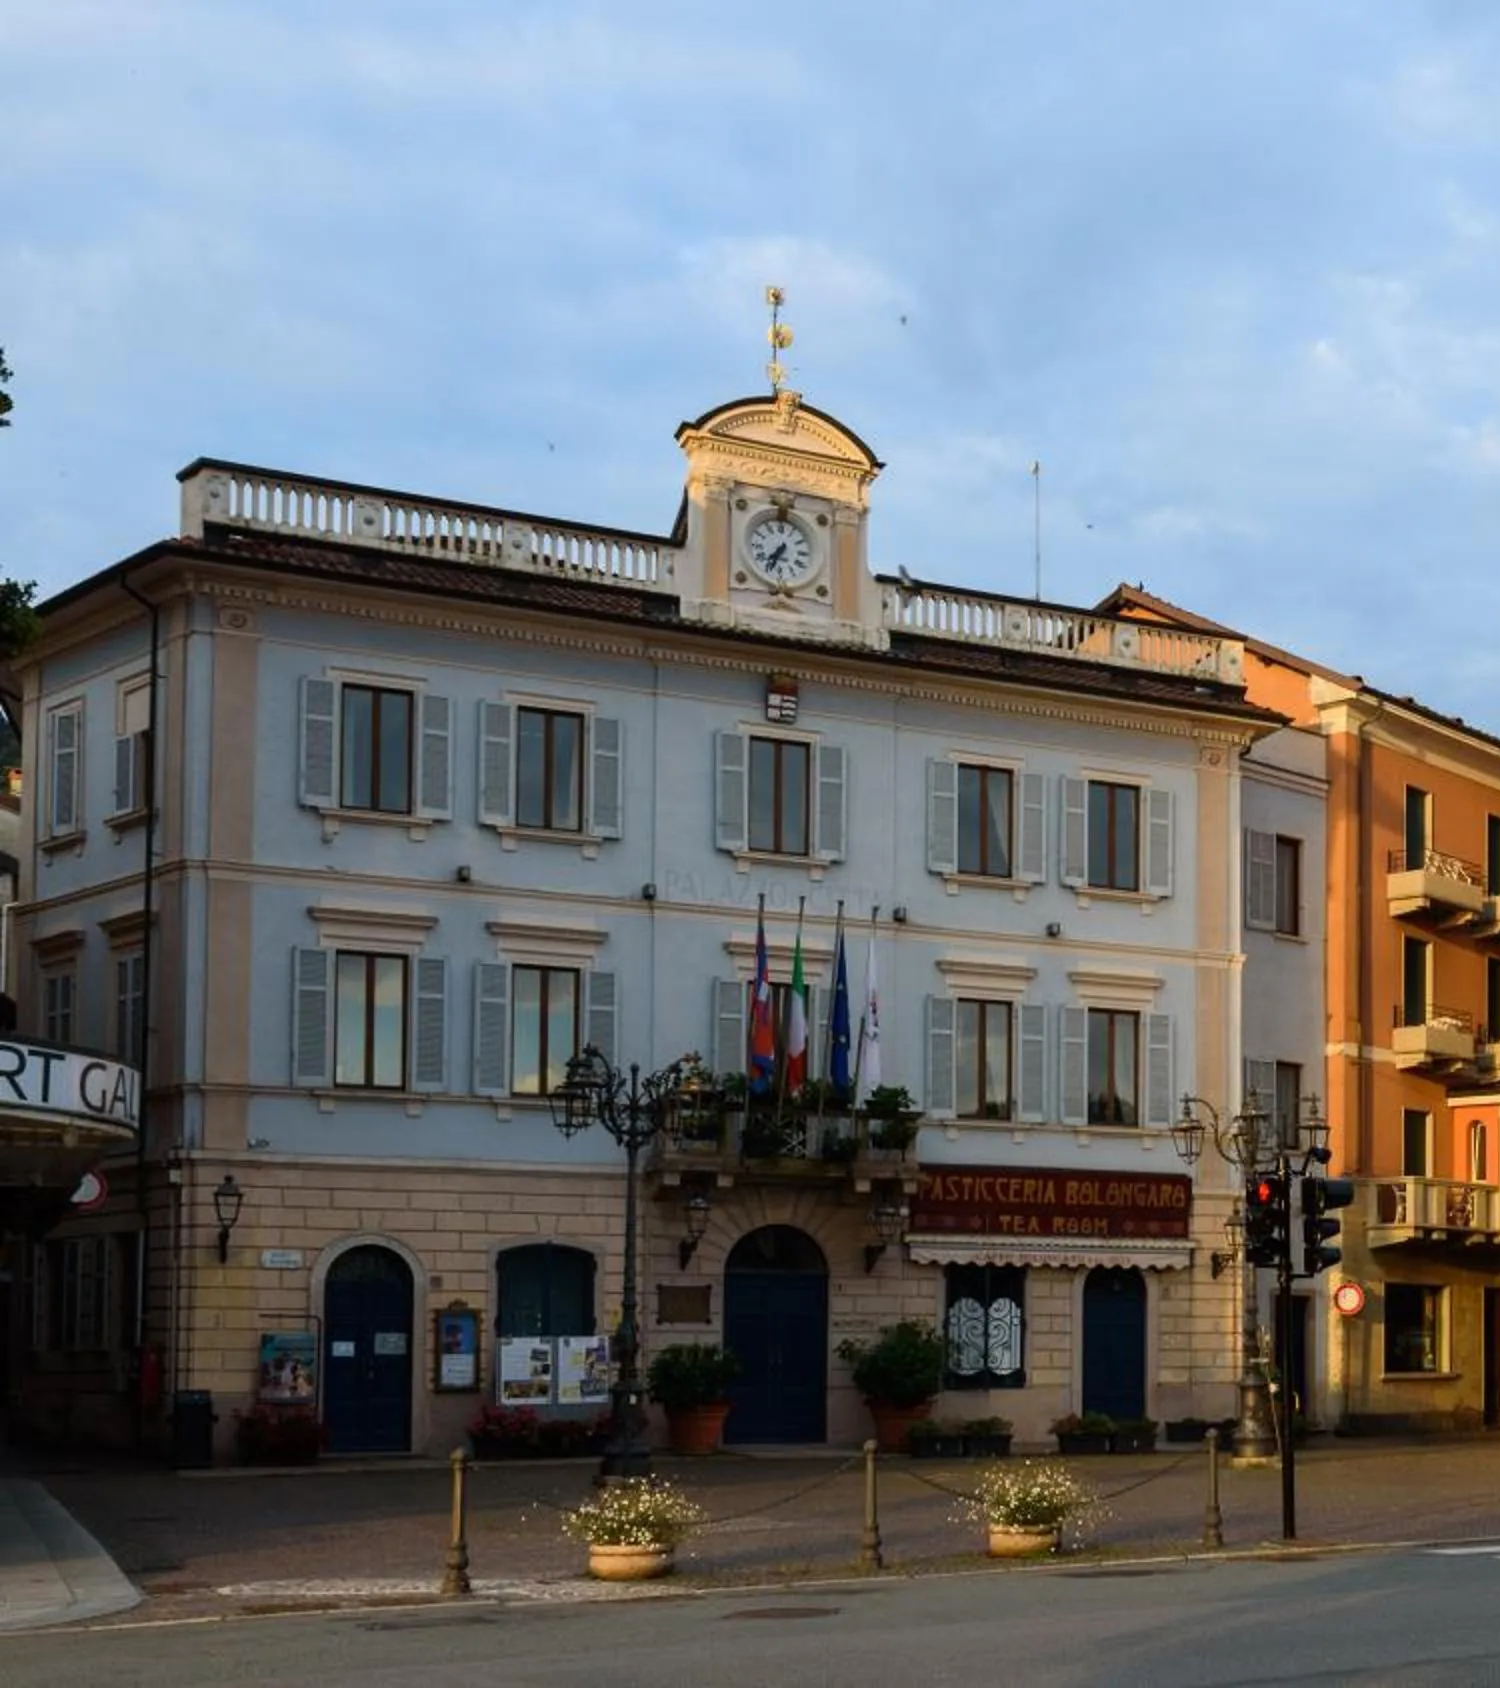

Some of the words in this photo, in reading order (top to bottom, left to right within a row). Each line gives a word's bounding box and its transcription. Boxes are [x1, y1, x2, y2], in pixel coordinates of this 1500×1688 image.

[918, 1175, 1056, 1205] PASTICCERIA
[998, 1214, 1041, 1233] TEA
[1052, 1216, 1109, 1235] ROOM
